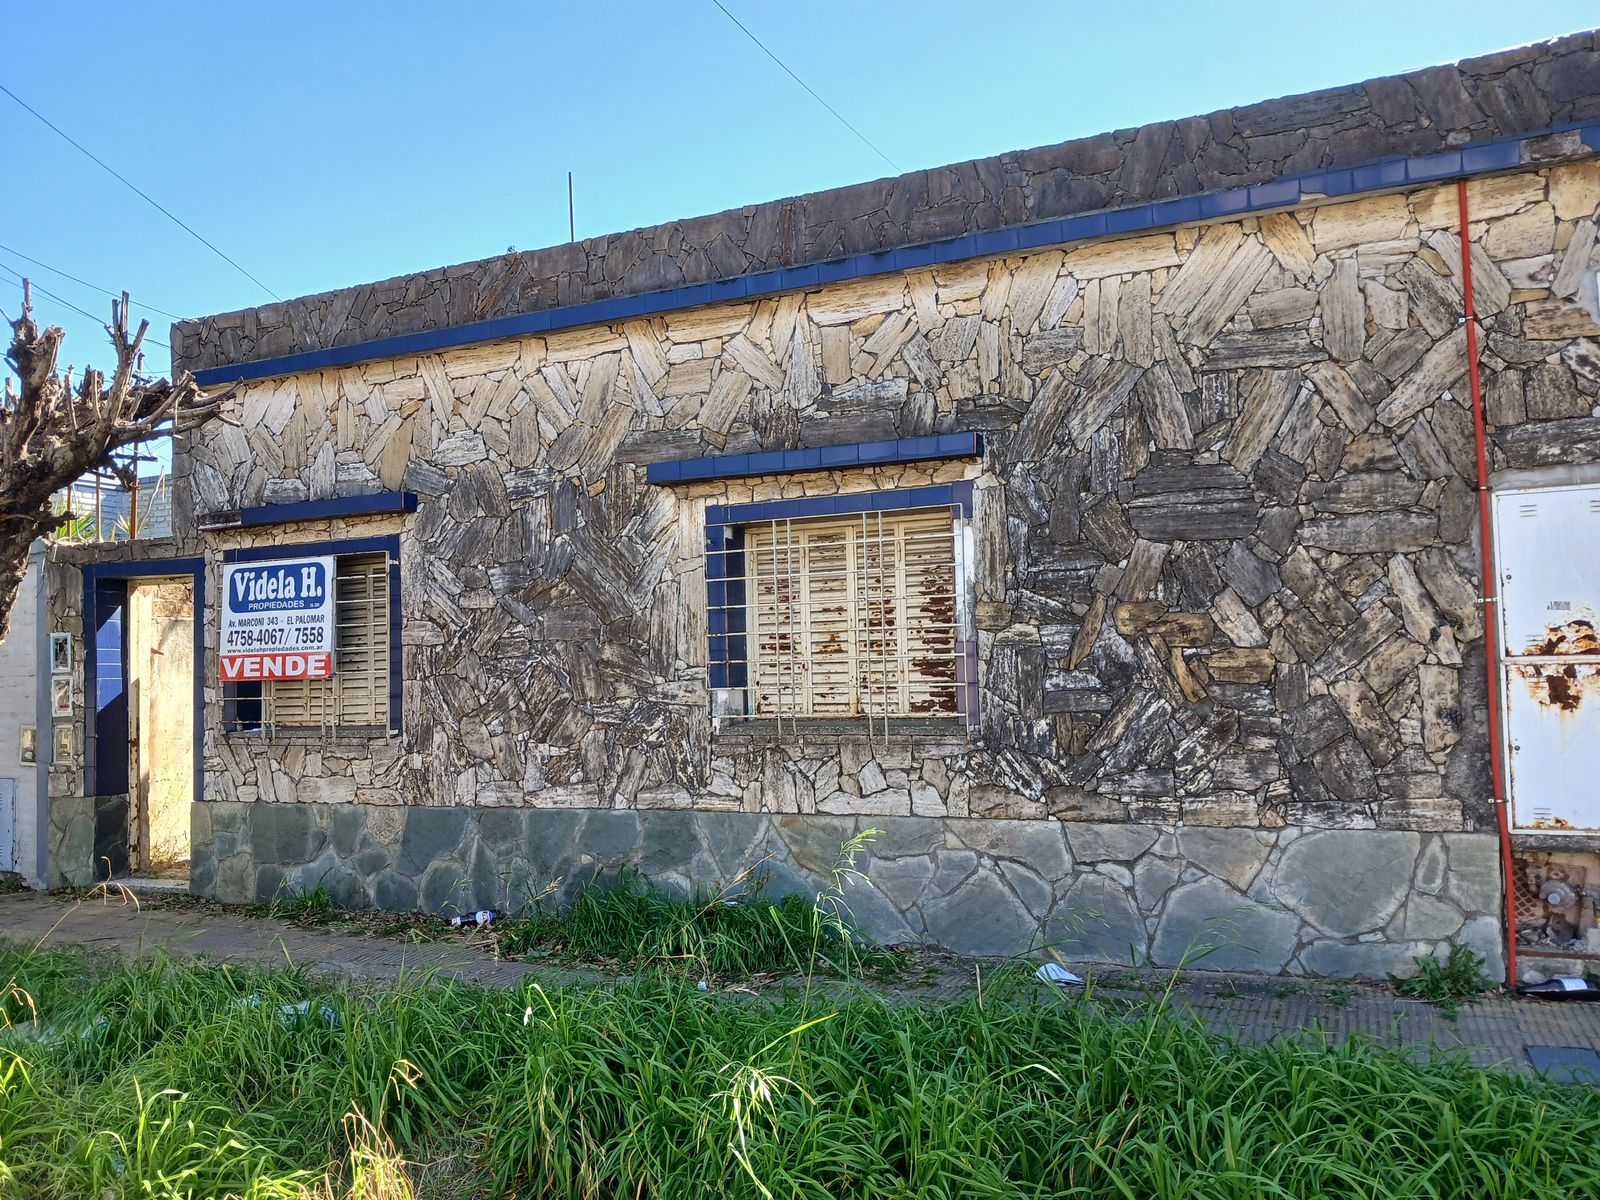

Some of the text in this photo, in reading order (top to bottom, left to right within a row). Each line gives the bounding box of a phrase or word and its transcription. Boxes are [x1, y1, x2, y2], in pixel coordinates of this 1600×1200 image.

[234, 566, 323, 602] Videla H.
[248, 600, 305, 611] PROPIEDADES
[228, 619, 237, 628] Av.
[238, 617, 264, 628] MARCONI
[267, 616, 279, 626] 343
[286, 615, 294, 625] EL
[295, 614, 325, 625] PALOMAR
[294, 626, 324, 645] 7558
[227, 645, 323, 654] www.videlahpropiedades.com.ar
[221, 655, 327, 678] VENDE
